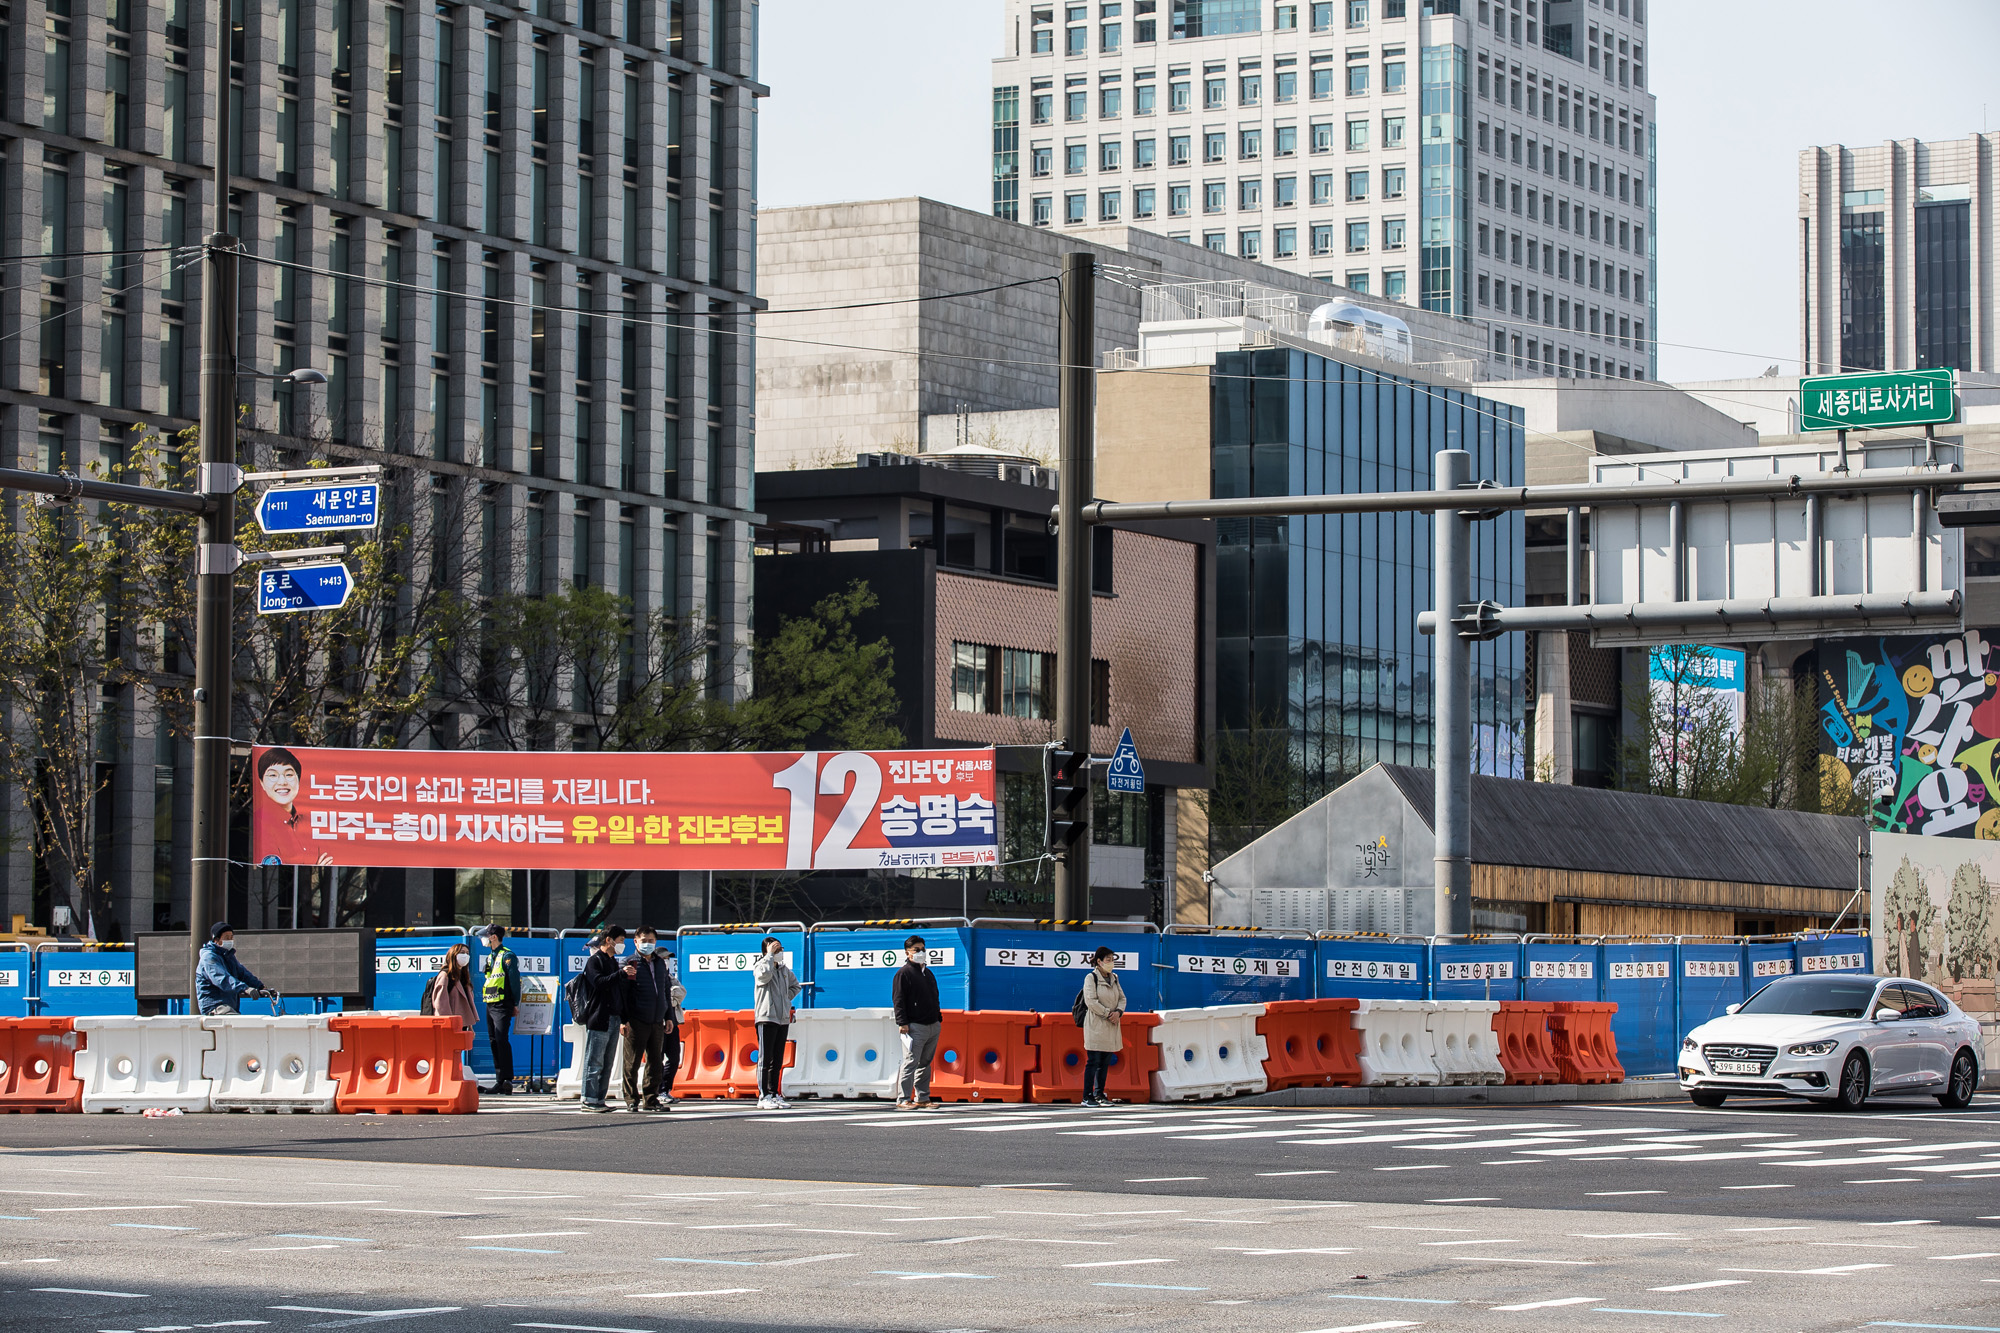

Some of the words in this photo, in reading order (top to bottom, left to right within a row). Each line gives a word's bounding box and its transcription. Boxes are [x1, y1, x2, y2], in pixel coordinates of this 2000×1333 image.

[1817, 381, 1934, 417] 세종대로사거리
[312, 488, 373, 510] 새문안로
[305, 513, 372, 526] Saemunan-ro
[264, 574, 292, 593] 종로
[263, 596, 303, 609] Jong-ro
[888, 759, 954, 784] 진보당
[955, 760, 992, 771] 서울시장
[956, 772, 974, 782] 후보
[1111, 777, 1142, 790] 자전거횡단
[309, 774, 407, 803] 노동자의
[415, 777, 464, 803] 삶과
[470, 778, 543, 804] 권리를
[551, 779, 655, 805] 지킵니다.
[773, 752, 882, 869] 12
[880, 793, 994, 836] 송명숙
[309, 811, 446, 842] 민주노총이
[455, 814, 563, 843] 지지하는
[678, 815, 784, 844] 진보후보
[941, 850, 995, 864] 평등서울
[407, 957, 443, 971] 제일
[523, 957, 544, 971] 제일
[698, 956, 730, 970] 안전
[835, 952, 874, 967] 안전
[998, 950, 1044, 967] 안전
[1807, 957, 1828, 971] 안전
[1840, 954, 1861, 970] 제일
[1188, 957, 1226, 973] 안전
[1253, 960, 1290, 976] 제일
[1334, 961, 1363, 977] 안전
[1382, 963, 1411, 979] 제일
[1446, 964, 1470, 980] 안전
[1484, 962, 1508, 978] 제일
[1534, 963, 1556, 978] 안전
[1568, 963, 1589, 978] 제일
[1614, 964, 1634, 978] 안전
[1645, 961, 1665, 977] 제일
[1689, 963, 1707, 976] 안전
[1718, 963, 1735, 976] 제일
[1757, 961, 1777, 975] 안전
[58, 972, 92, 985] 안전
[1736, 1063, 1757, 1073] 8155
